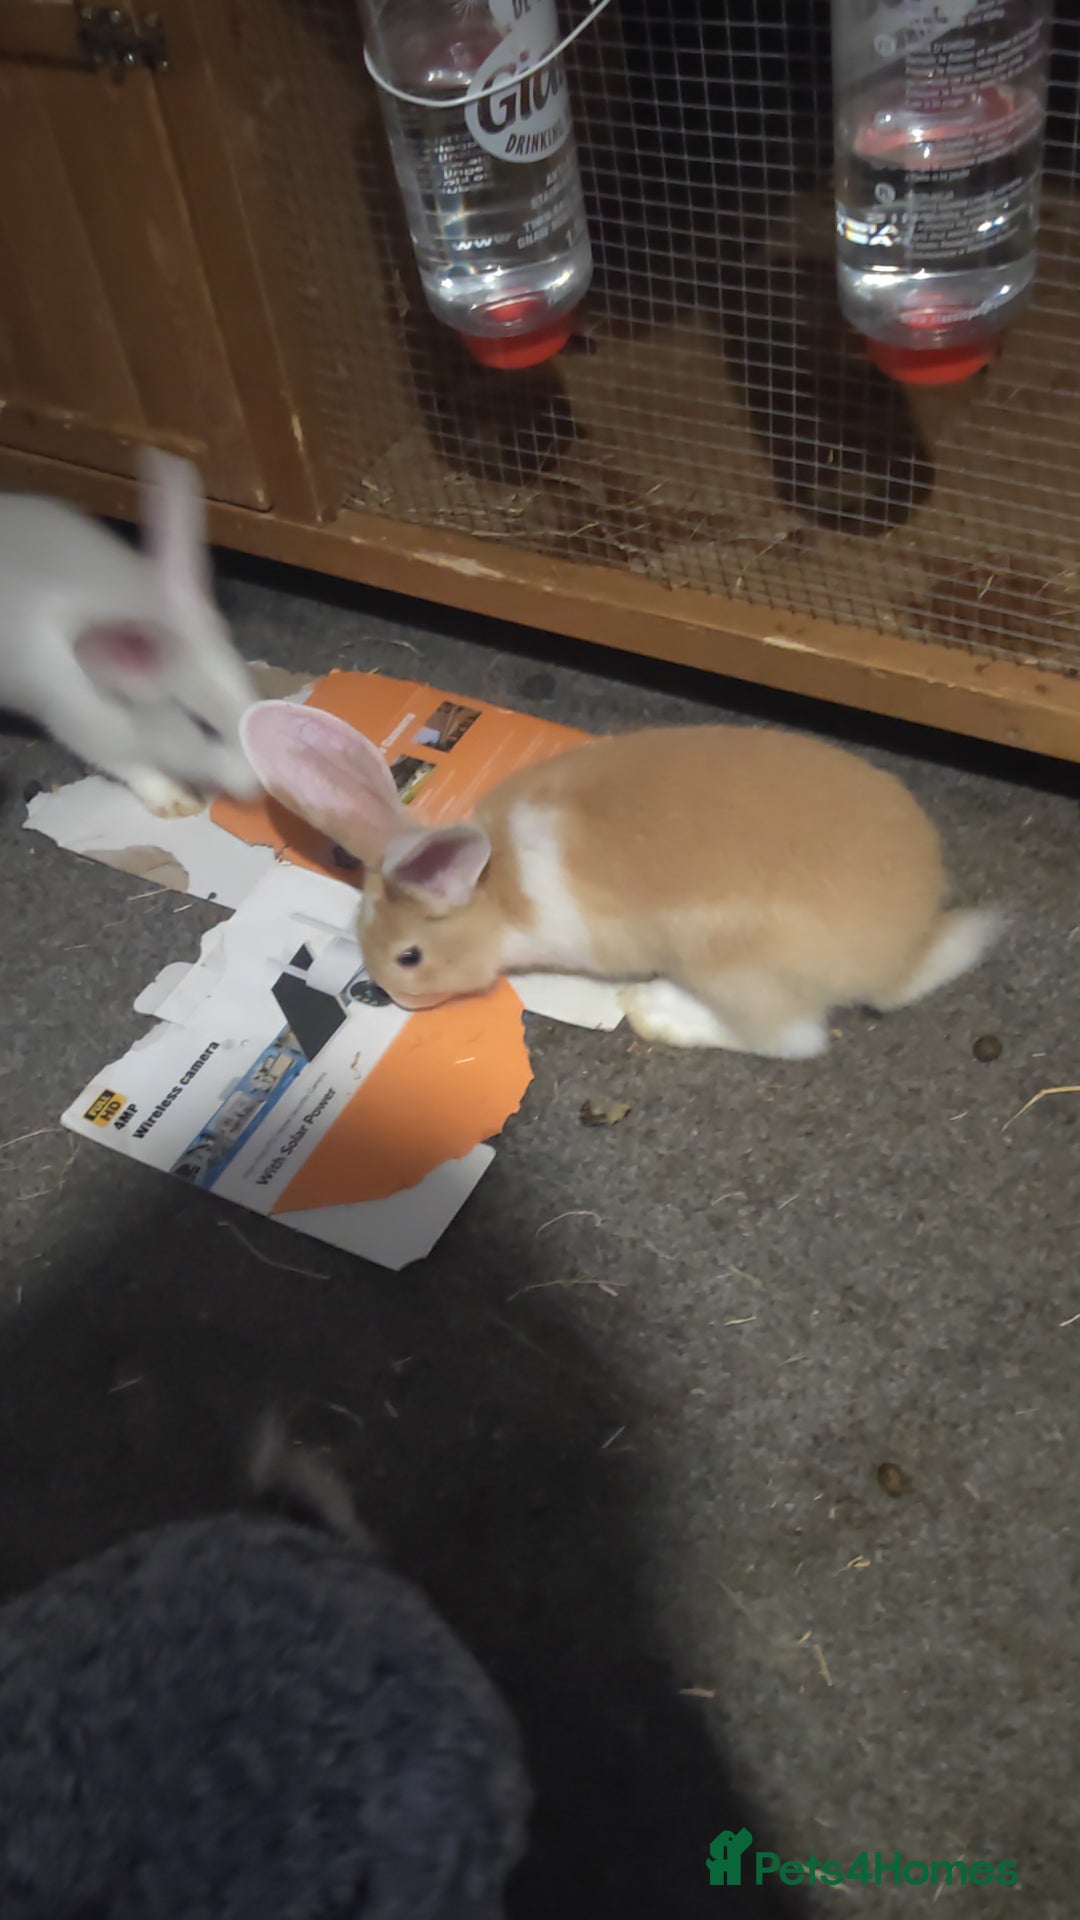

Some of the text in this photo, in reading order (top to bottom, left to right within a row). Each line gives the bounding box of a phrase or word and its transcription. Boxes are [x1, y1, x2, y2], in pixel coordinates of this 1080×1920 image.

[100, 1100, 122, 1121] HD
[113, 1102, 139, 1131] 4MP
[132, 1040, 221, 1140] Wireless camera
[255, 1156, 286, 1187] With
[280, 1123, 309, 1157] Solar
[305, 1086, 337, 1126] Power
